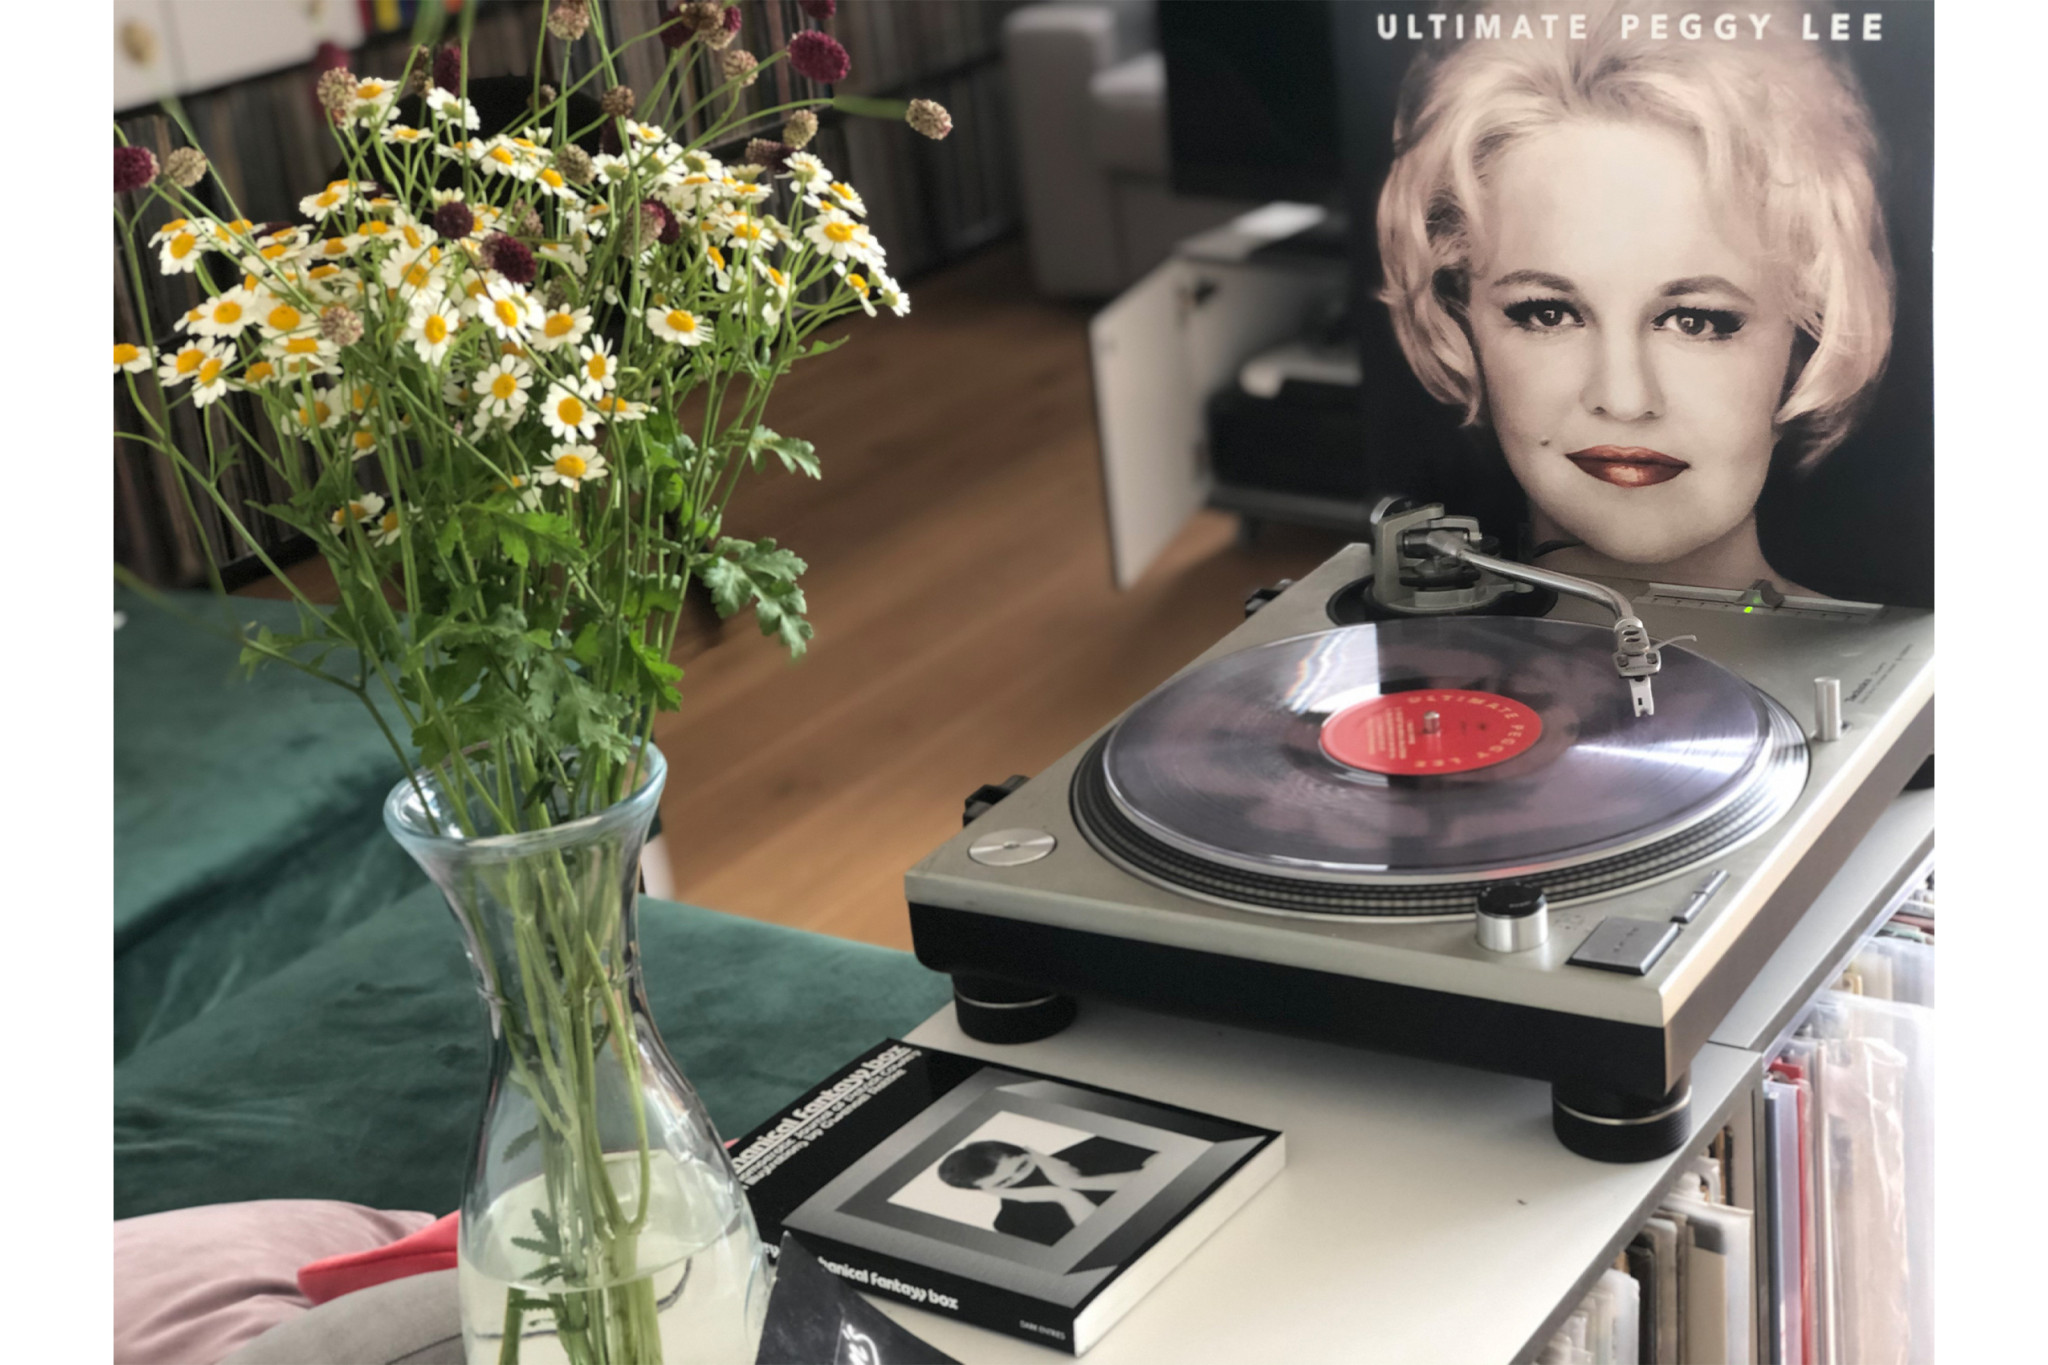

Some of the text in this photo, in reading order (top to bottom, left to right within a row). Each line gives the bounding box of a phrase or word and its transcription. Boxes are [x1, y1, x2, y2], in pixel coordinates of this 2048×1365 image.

[1377, 13, 1882, 41] ULTIMATE PEGGY LEE
[1408, 695, 1519, 719] ULTIMATE
